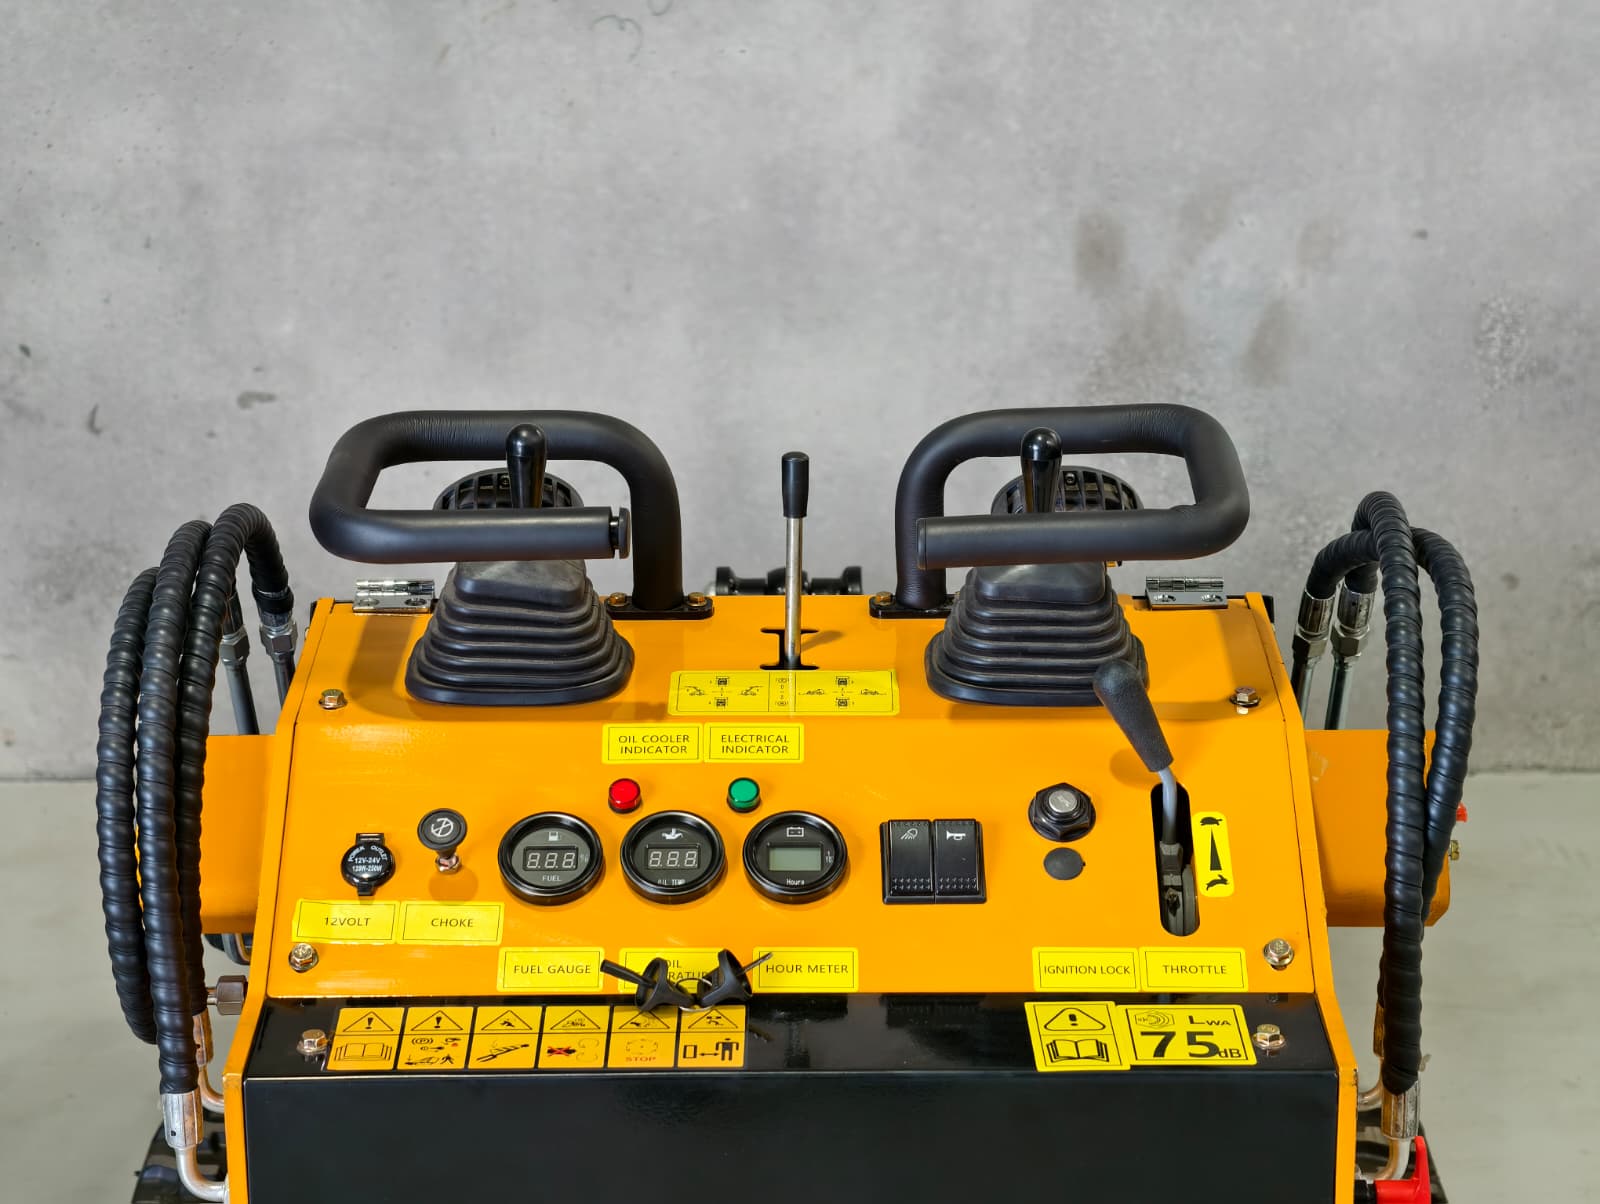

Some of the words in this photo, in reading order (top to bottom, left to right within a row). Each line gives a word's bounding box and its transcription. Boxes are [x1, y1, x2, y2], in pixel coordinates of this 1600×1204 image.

[618, 735, 638, 744] OIL
[641, 734, 690, 744] COOLER
[721, 734, 790, 744] ELECTRICAL
[620, 745, 688, 754] INDICATOR
[721, 745, 789, 754] INDICATOR
[786, 878, 805, 886] Hours
[324, 916, 372, 927] 12VOLT
[430, 917, 474, 928] CHOKE
[513, 964, 543, 974] FUEL
[547, 964, 591, 975] GAUGE
[766, 964, 803, 974] HOUR
[807, 964, 849, 974] METER
[1044, 965, 1097, 975] IGNITION
[1100, 965, 1131, 975] LOCK
[1162, 964, 1227, 975] THROTTLE
